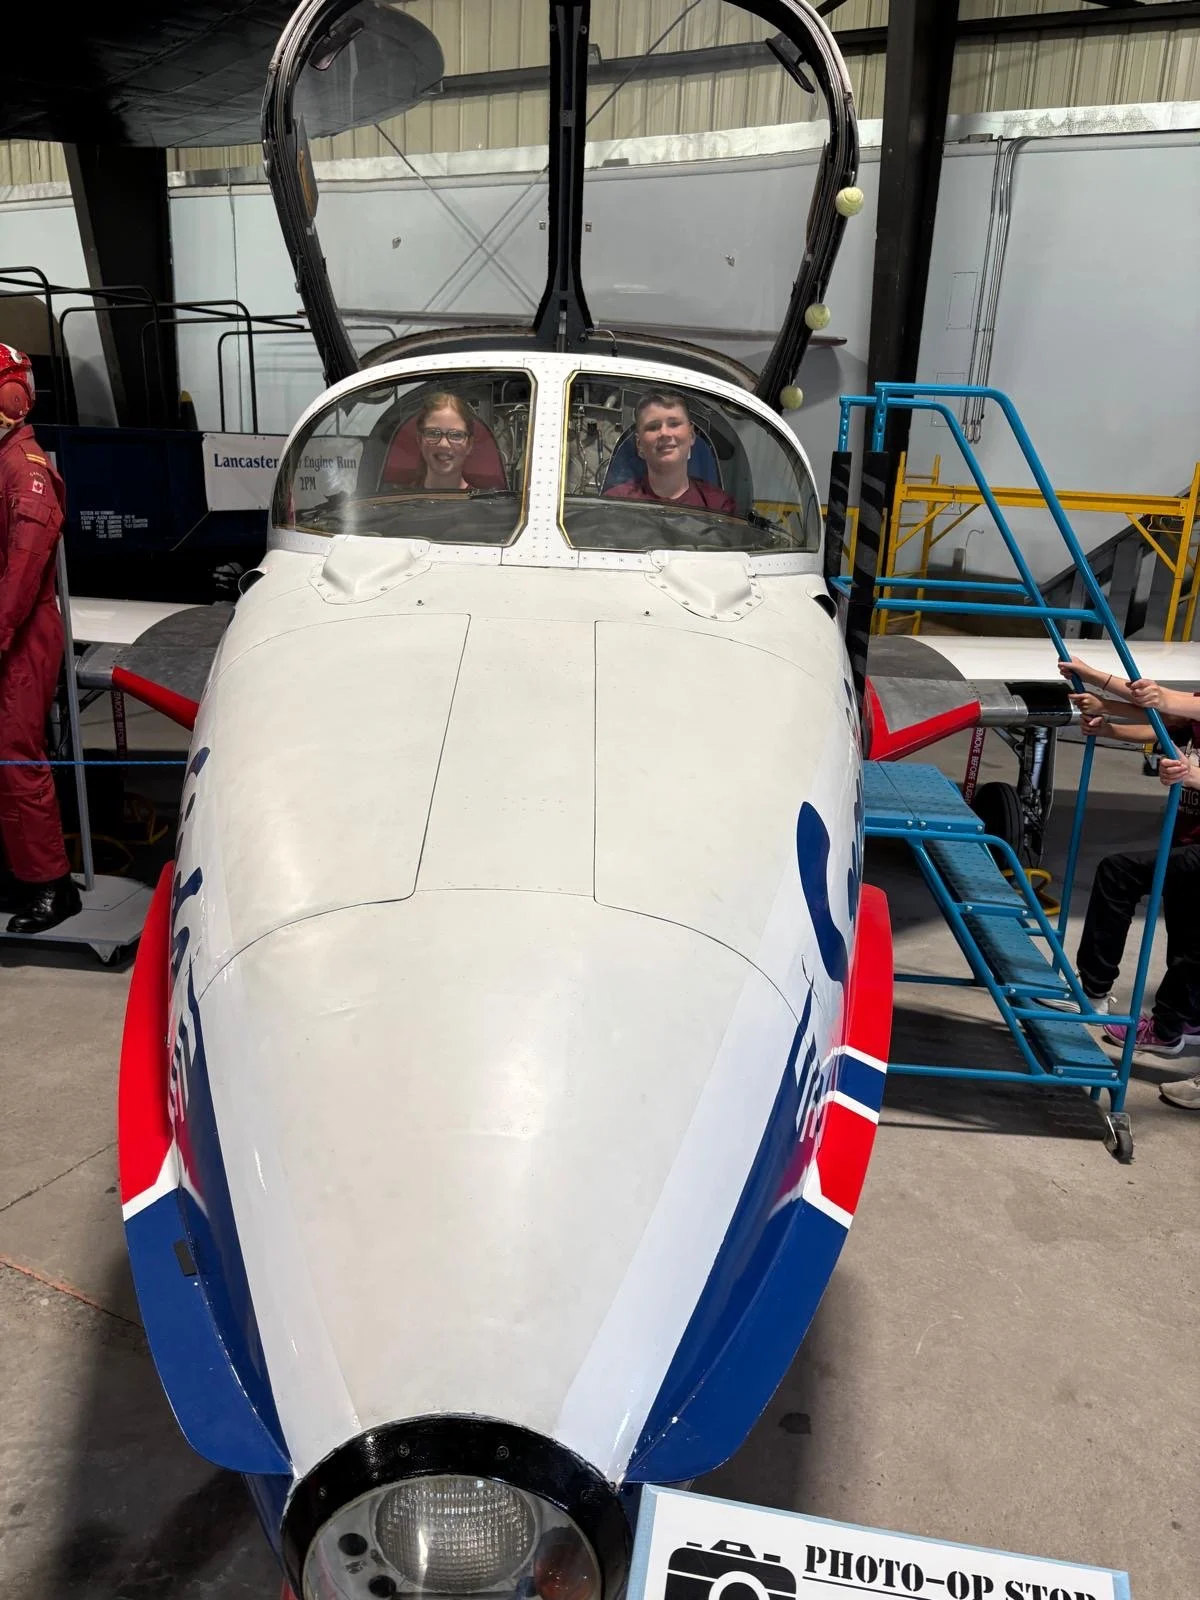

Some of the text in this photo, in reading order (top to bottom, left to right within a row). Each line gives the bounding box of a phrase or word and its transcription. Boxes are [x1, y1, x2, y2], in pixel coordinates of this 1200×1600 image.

[213, 453, 279, 469] Lancaster
[304, 455, 333, 472] Engine
[337, 456, 357, 469] Run
[968, 756, 979, 780] BEFORE
[804, 1544, 994, 1600] PHOTO-OP
